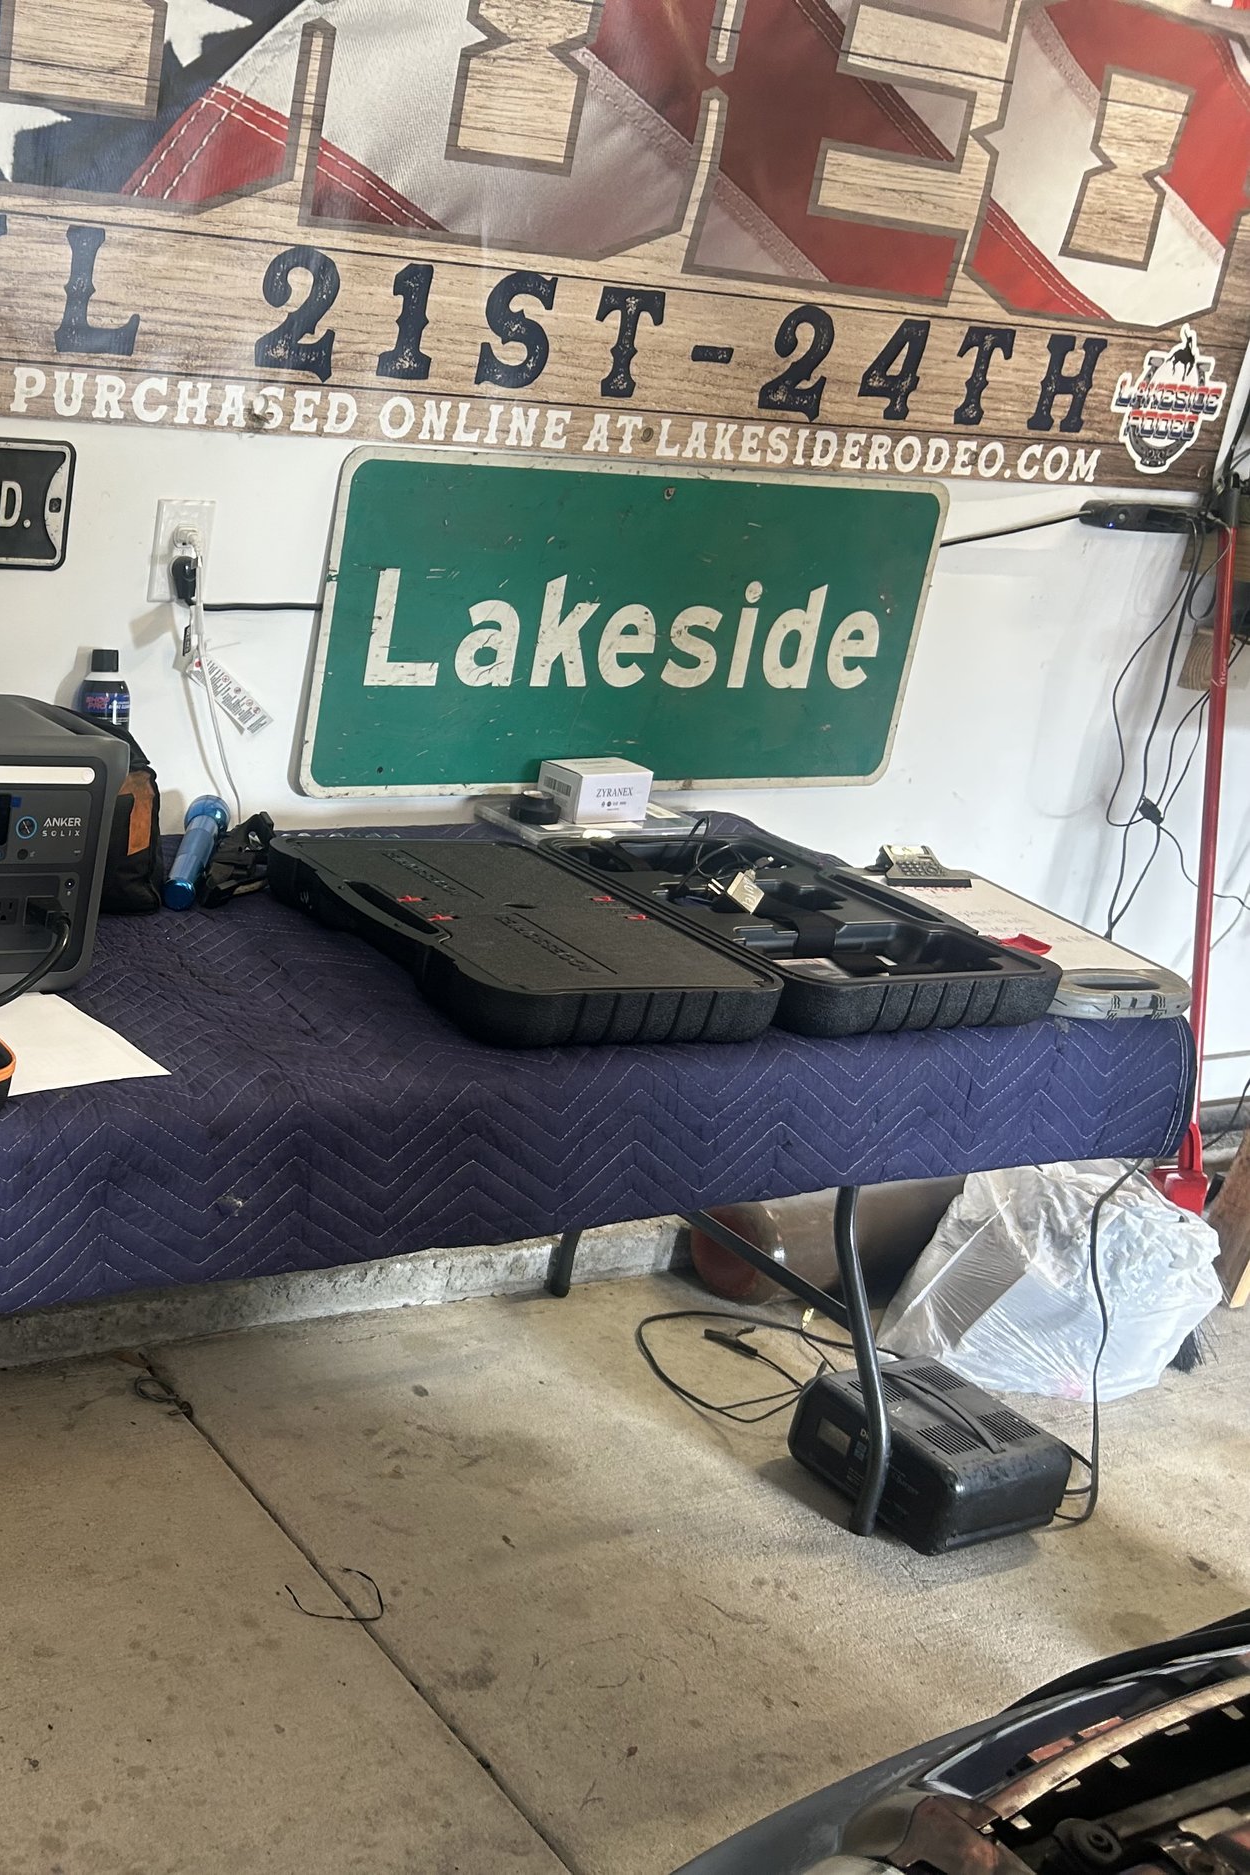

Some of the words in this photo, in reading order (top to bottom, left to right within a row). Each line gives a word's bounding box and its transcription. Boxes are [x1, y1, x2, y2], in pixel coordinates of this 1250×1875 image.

[254, 245, 1109, 434] 21ST-24TH
[1114, 378, 1223, 415] LAKESIDE
[9, 365, 359, 435] PURCHASED
[378, 396, 571, 451] ONLINE
[581, 415, 643, 454] AT
[655, 418, 1103, 484] LAKESIDERODEO.COM
[1123, 409, 1199, 442] RODEO
[362, 566, 882, 690] Lakeside
[596, 786, 634, 799] ZYRANEX
[41, 829, 81, 838] SOLIX
[42, 816, 82, 828] ANKER
